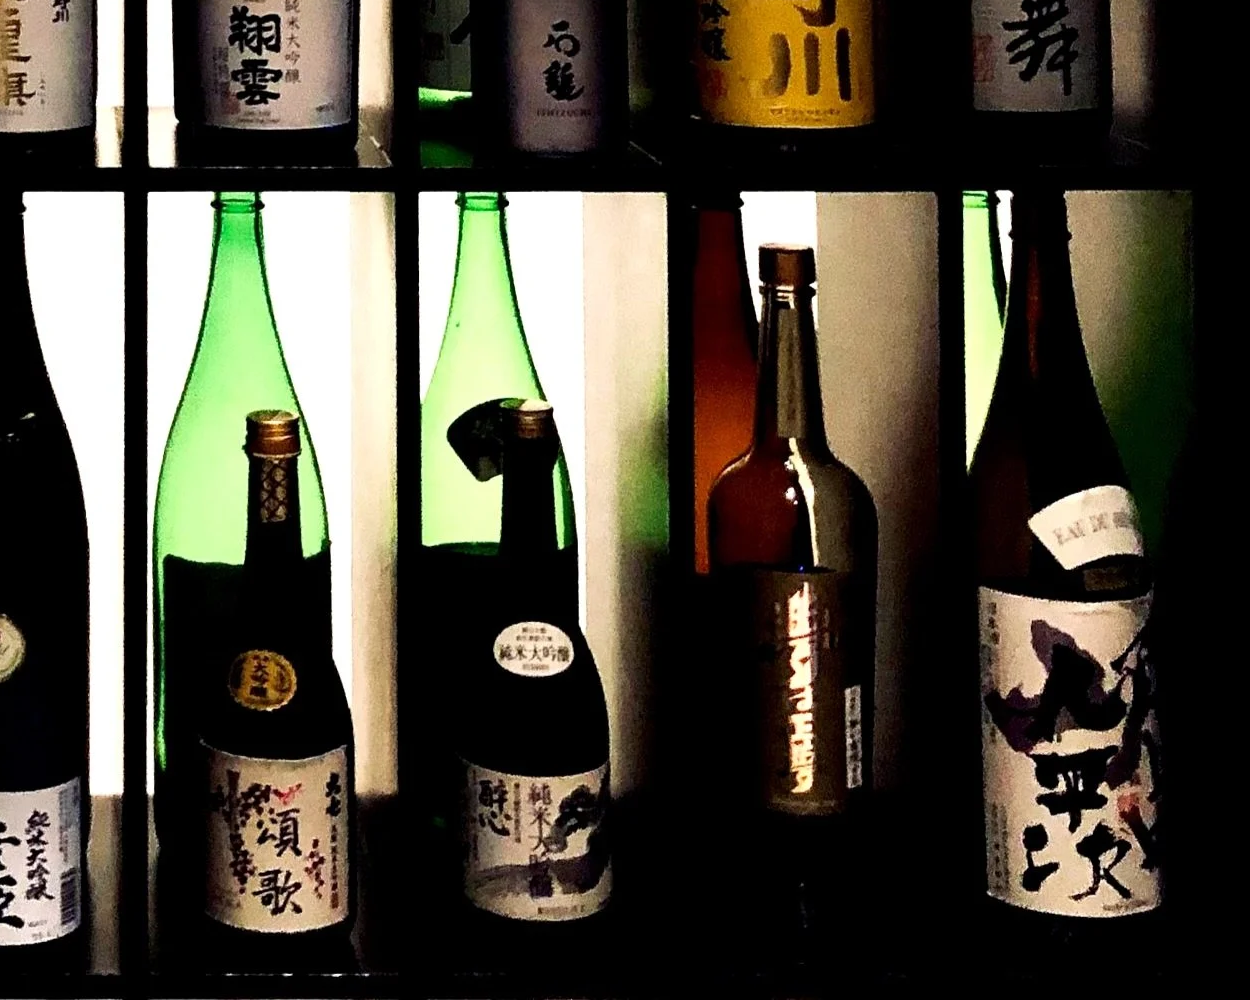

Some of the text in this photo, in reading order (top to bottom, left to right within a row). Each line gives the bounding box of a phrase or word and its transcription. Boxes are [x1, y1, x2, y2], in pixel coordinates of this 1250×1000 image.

[228, 4, 283, 107] 翔雲
[498, 643, 570, 663] 純米大吟醸
[252, 808, 302, 916] 頌歌
